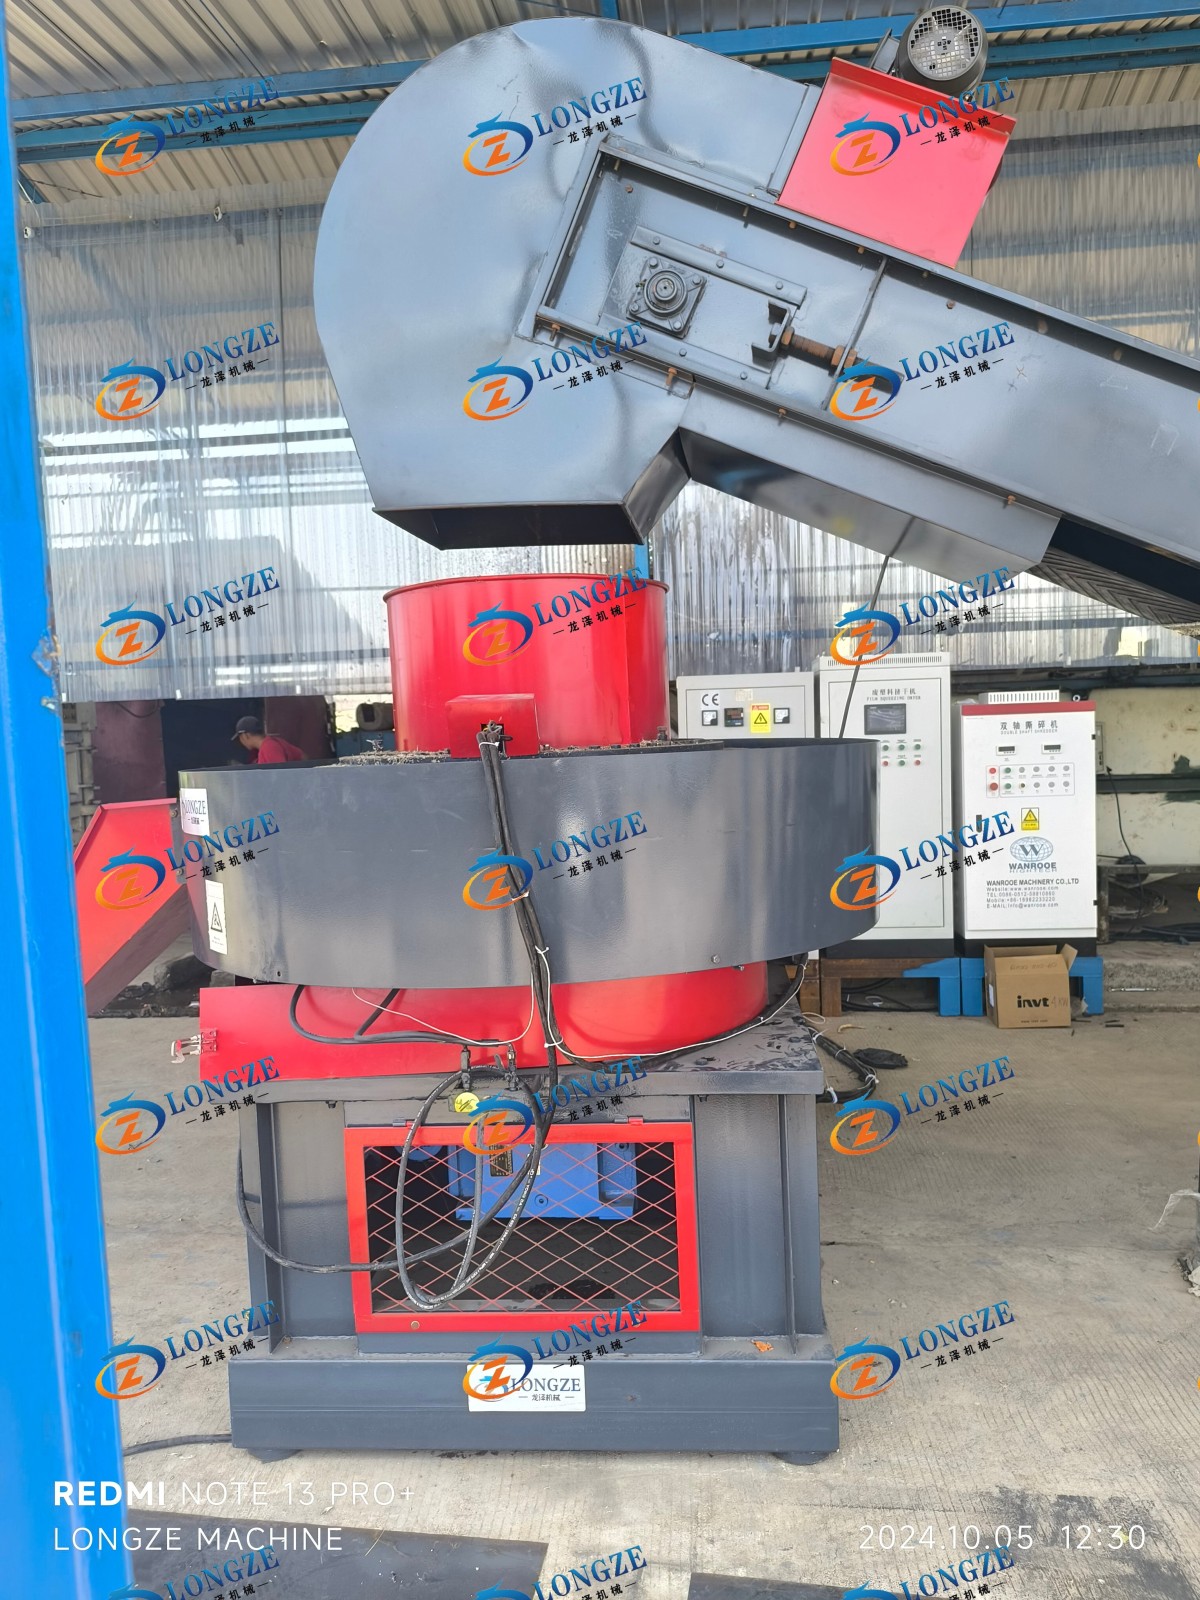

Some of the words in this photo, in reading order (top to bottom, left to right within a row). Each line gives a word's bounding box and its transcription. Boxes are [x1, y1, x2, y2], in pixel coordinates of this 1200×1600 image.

[1009, 862, 1056, 870] WANROOE
[1019, 878, 1054, 886] MACHINERY
[1017, 995, 1049, 1008] invt
[512, 1378, 580, 1392] LONGZE
[532, 1394, 560, 1402] 龙泽机械
